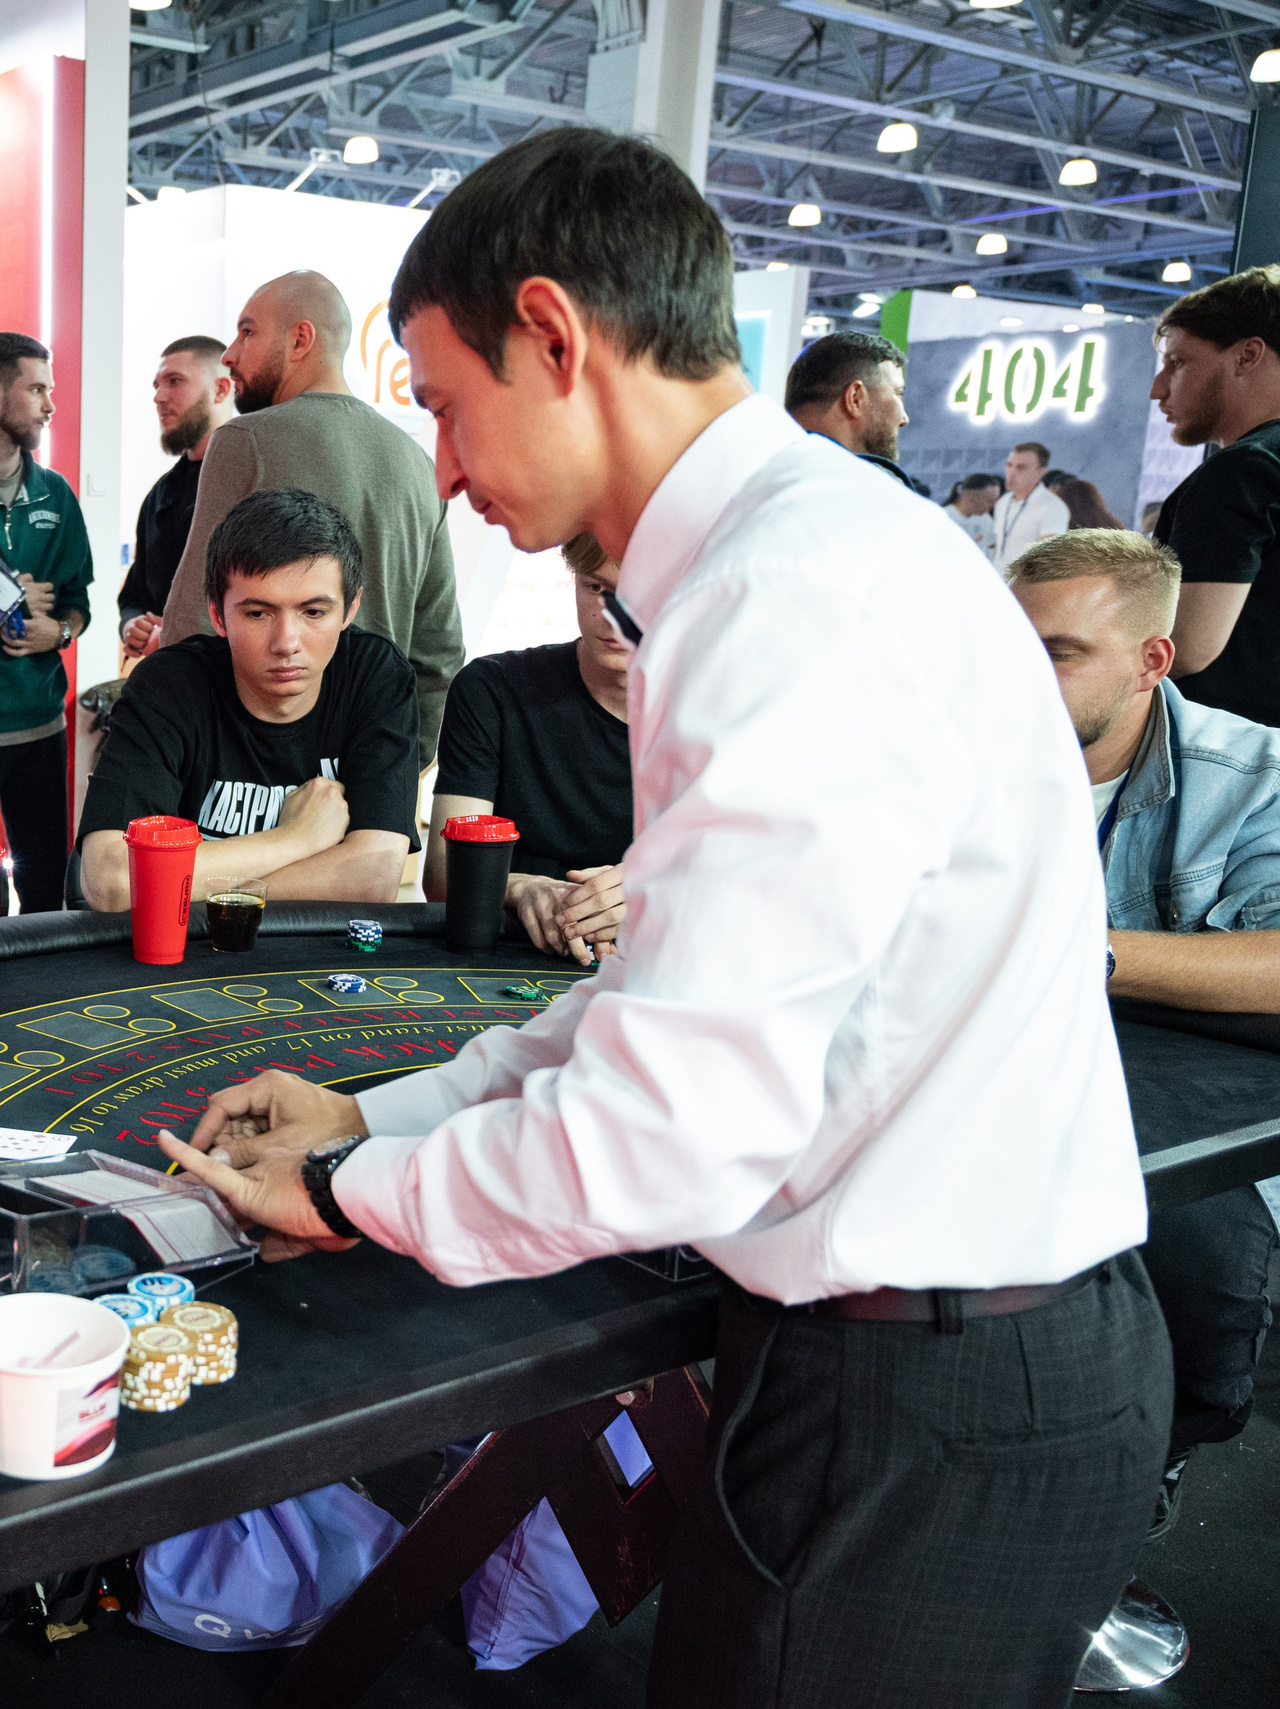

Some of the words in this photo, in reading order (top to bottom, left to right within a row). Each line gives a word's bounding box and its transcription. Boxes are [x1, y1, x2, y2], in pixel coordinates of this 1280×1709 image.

[954, 341, 1095, 416] 404
[158, 1025, 264, 1052] PAYS
[320, 1032, 352, 1042] on
[360, 1025, 435, 1040] stand
[445, 1025, 494, 1034] ust
[125, 1050, 156, 1061] 2
[220, 1045, 267, 1063] and
[342, 1039, 458, 1062] JACK
[71, 1063, 130, 1083] TO
[163, 1056, 220, 1079] must
[113, 1076, 164, 1103] draw
[91, 1102, 119, 1115] to
[139, 1101, 209, 1128] TO
[69, 1116, 104, 1134] 16
[115, 1129, 160, 1146] 2
